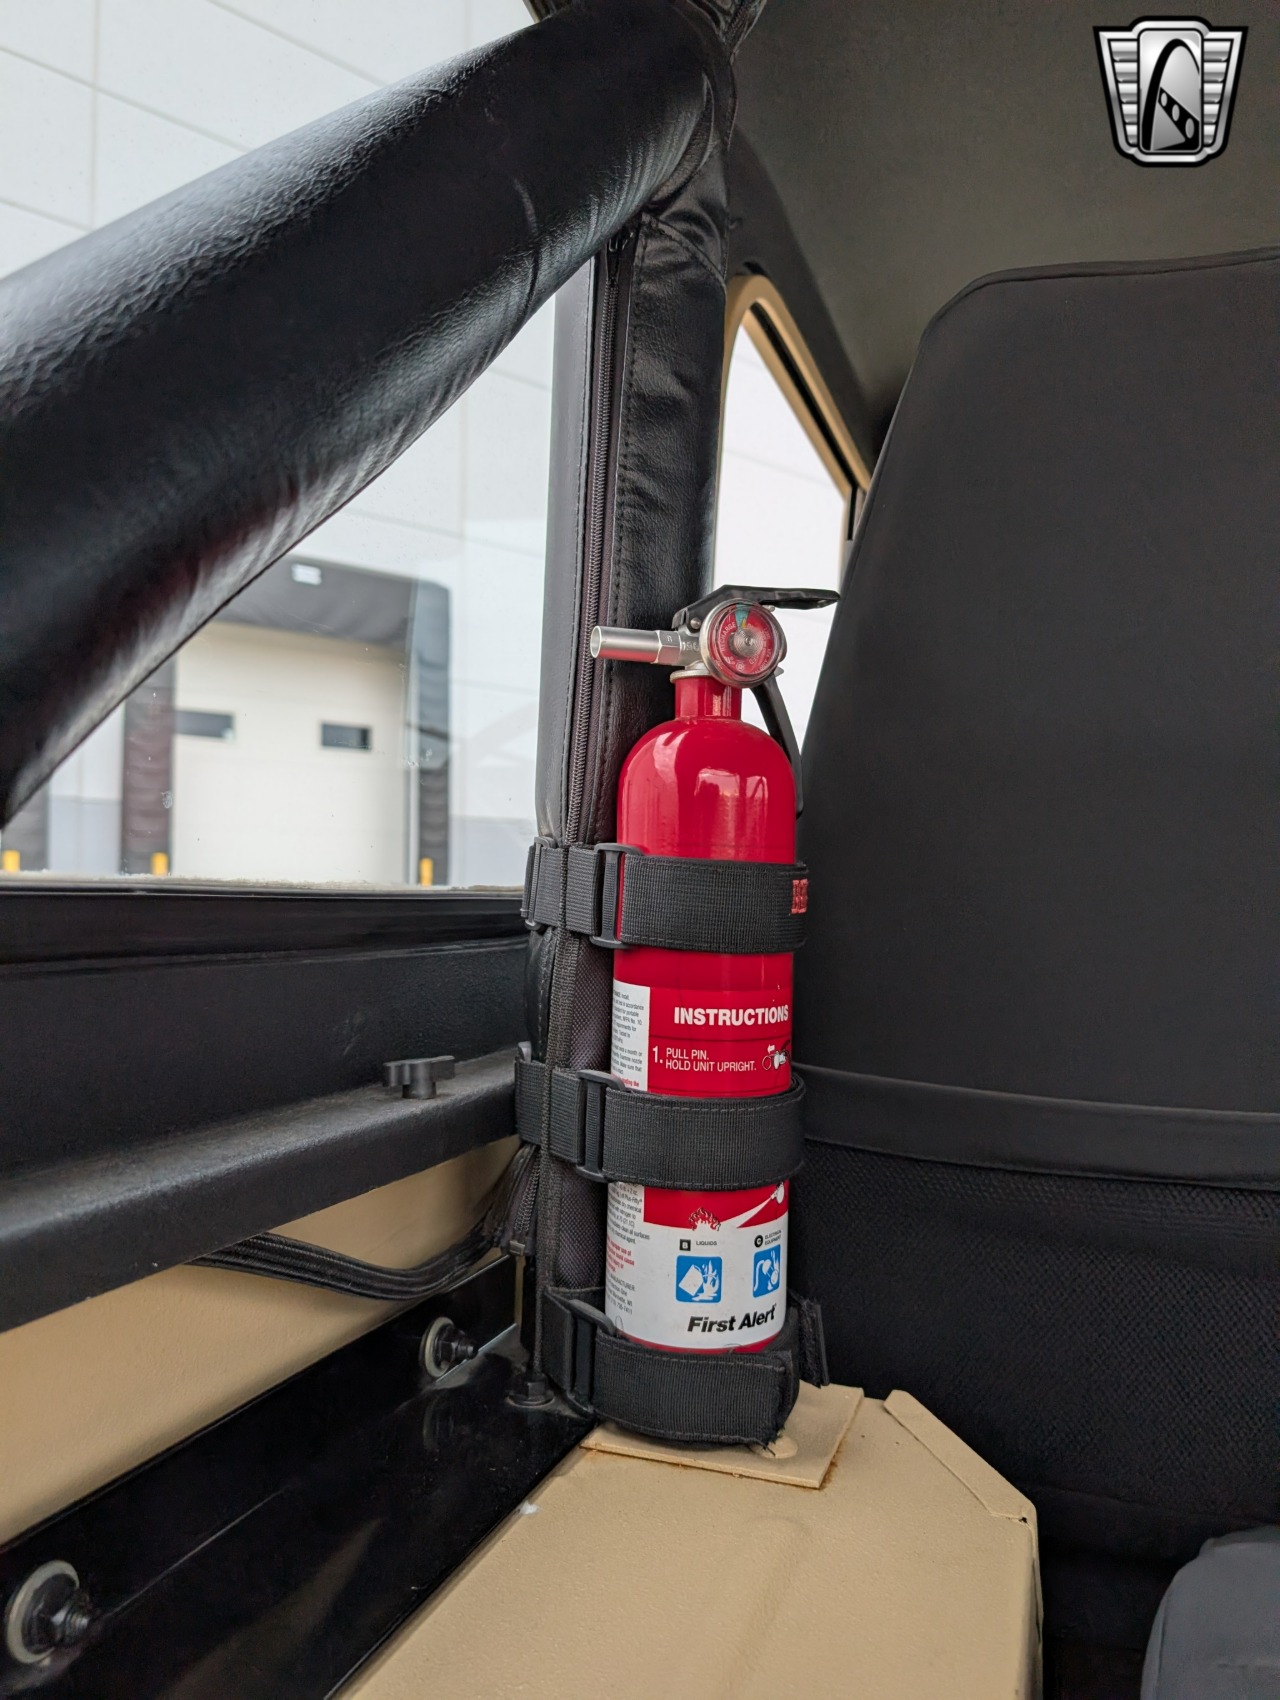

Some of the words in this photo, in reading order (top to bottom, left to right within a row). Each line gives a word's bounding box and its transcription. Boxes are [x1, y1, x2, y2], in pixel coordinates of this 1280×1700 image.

[674, 1004, 789, 1026] INSTRUCTIONS
[652, 1046, 663, 1064] 1.
[666, 1047, 689, 1060] PULL
[691, 1049, 709, 1060] PIN.
[665, 1060, 691, 1071] HOLD
[693, 1061, 715, 1072] UNIT
[717, 1061, 757, 1073] UPRIGHT.
[687, 1315, 735, 1333] First
[738, 1305, 776, 1330] Alert
